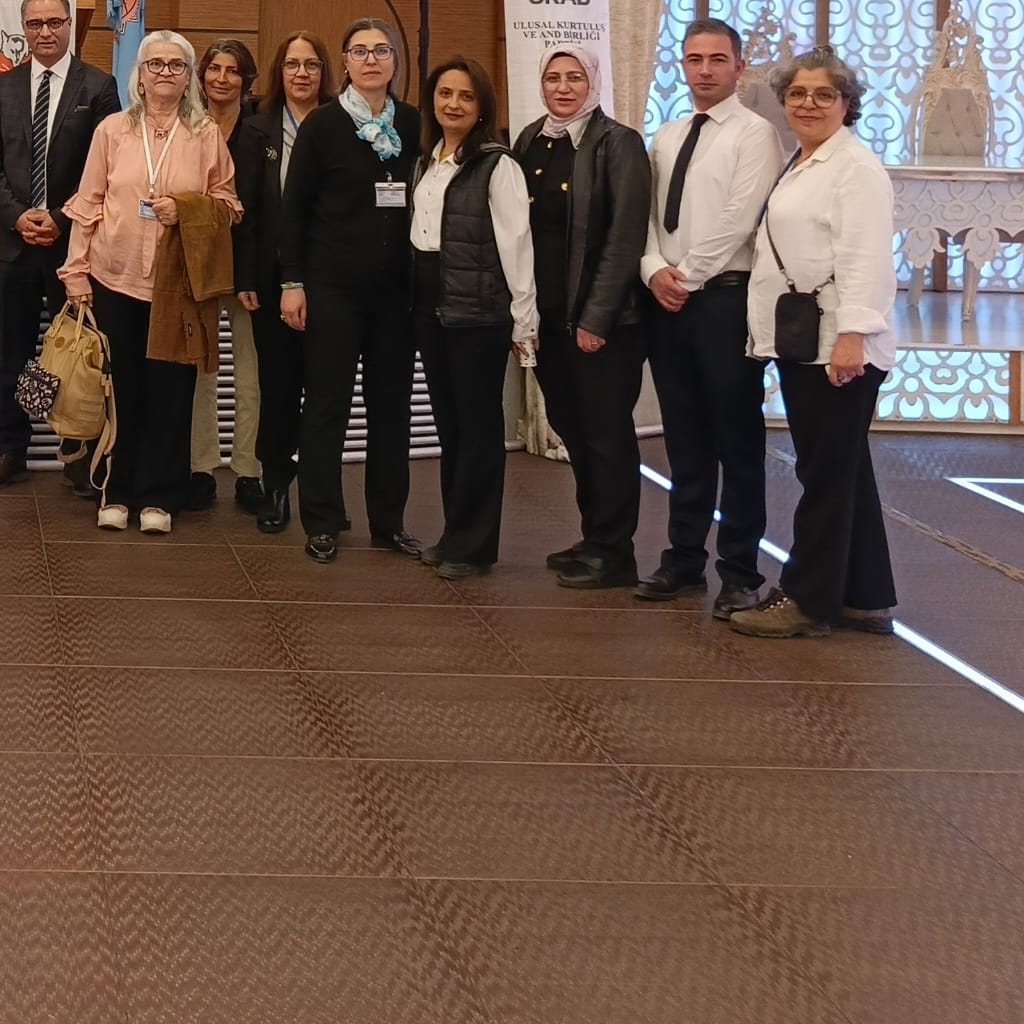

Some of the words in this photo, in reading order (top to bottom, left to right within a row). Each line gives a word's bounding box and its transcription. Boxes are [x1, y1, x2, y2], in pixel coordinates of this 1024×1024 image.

[513, 21, 555, 30] ULUSAL
[523, 31, 537, 39] VE
[539, 30, 562, 39] AND
